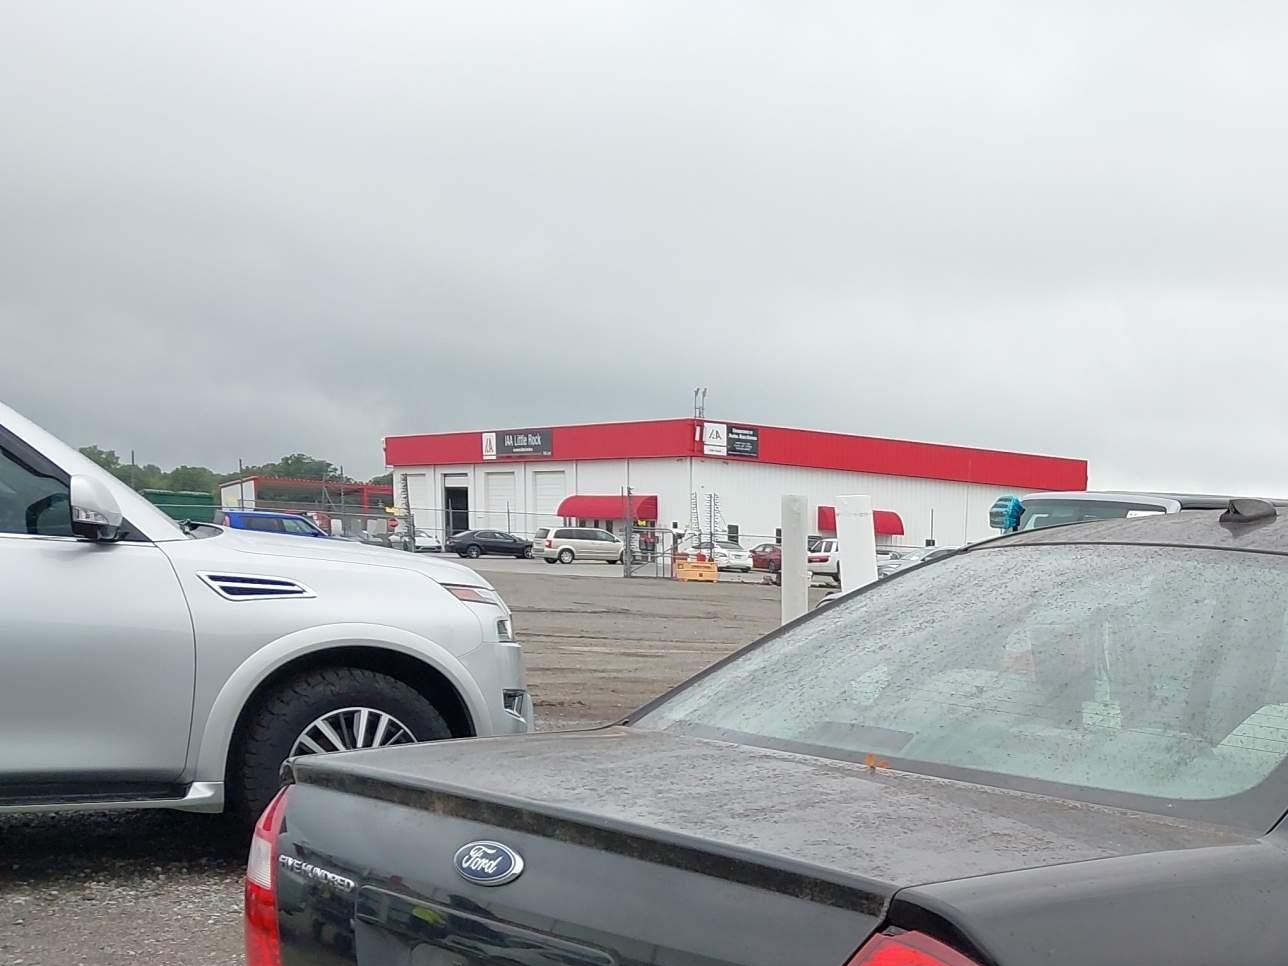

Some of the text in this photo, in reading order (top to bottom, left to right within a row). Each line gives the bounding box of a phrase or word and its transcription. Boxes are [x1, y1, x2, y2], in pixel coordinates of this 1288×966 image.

[514, 434, 528, 446] Little
[528, 432, 542, 446] Rock
[461, 845, 504, 874] Ford
[302, 863, 355, 893] HUNDRED
